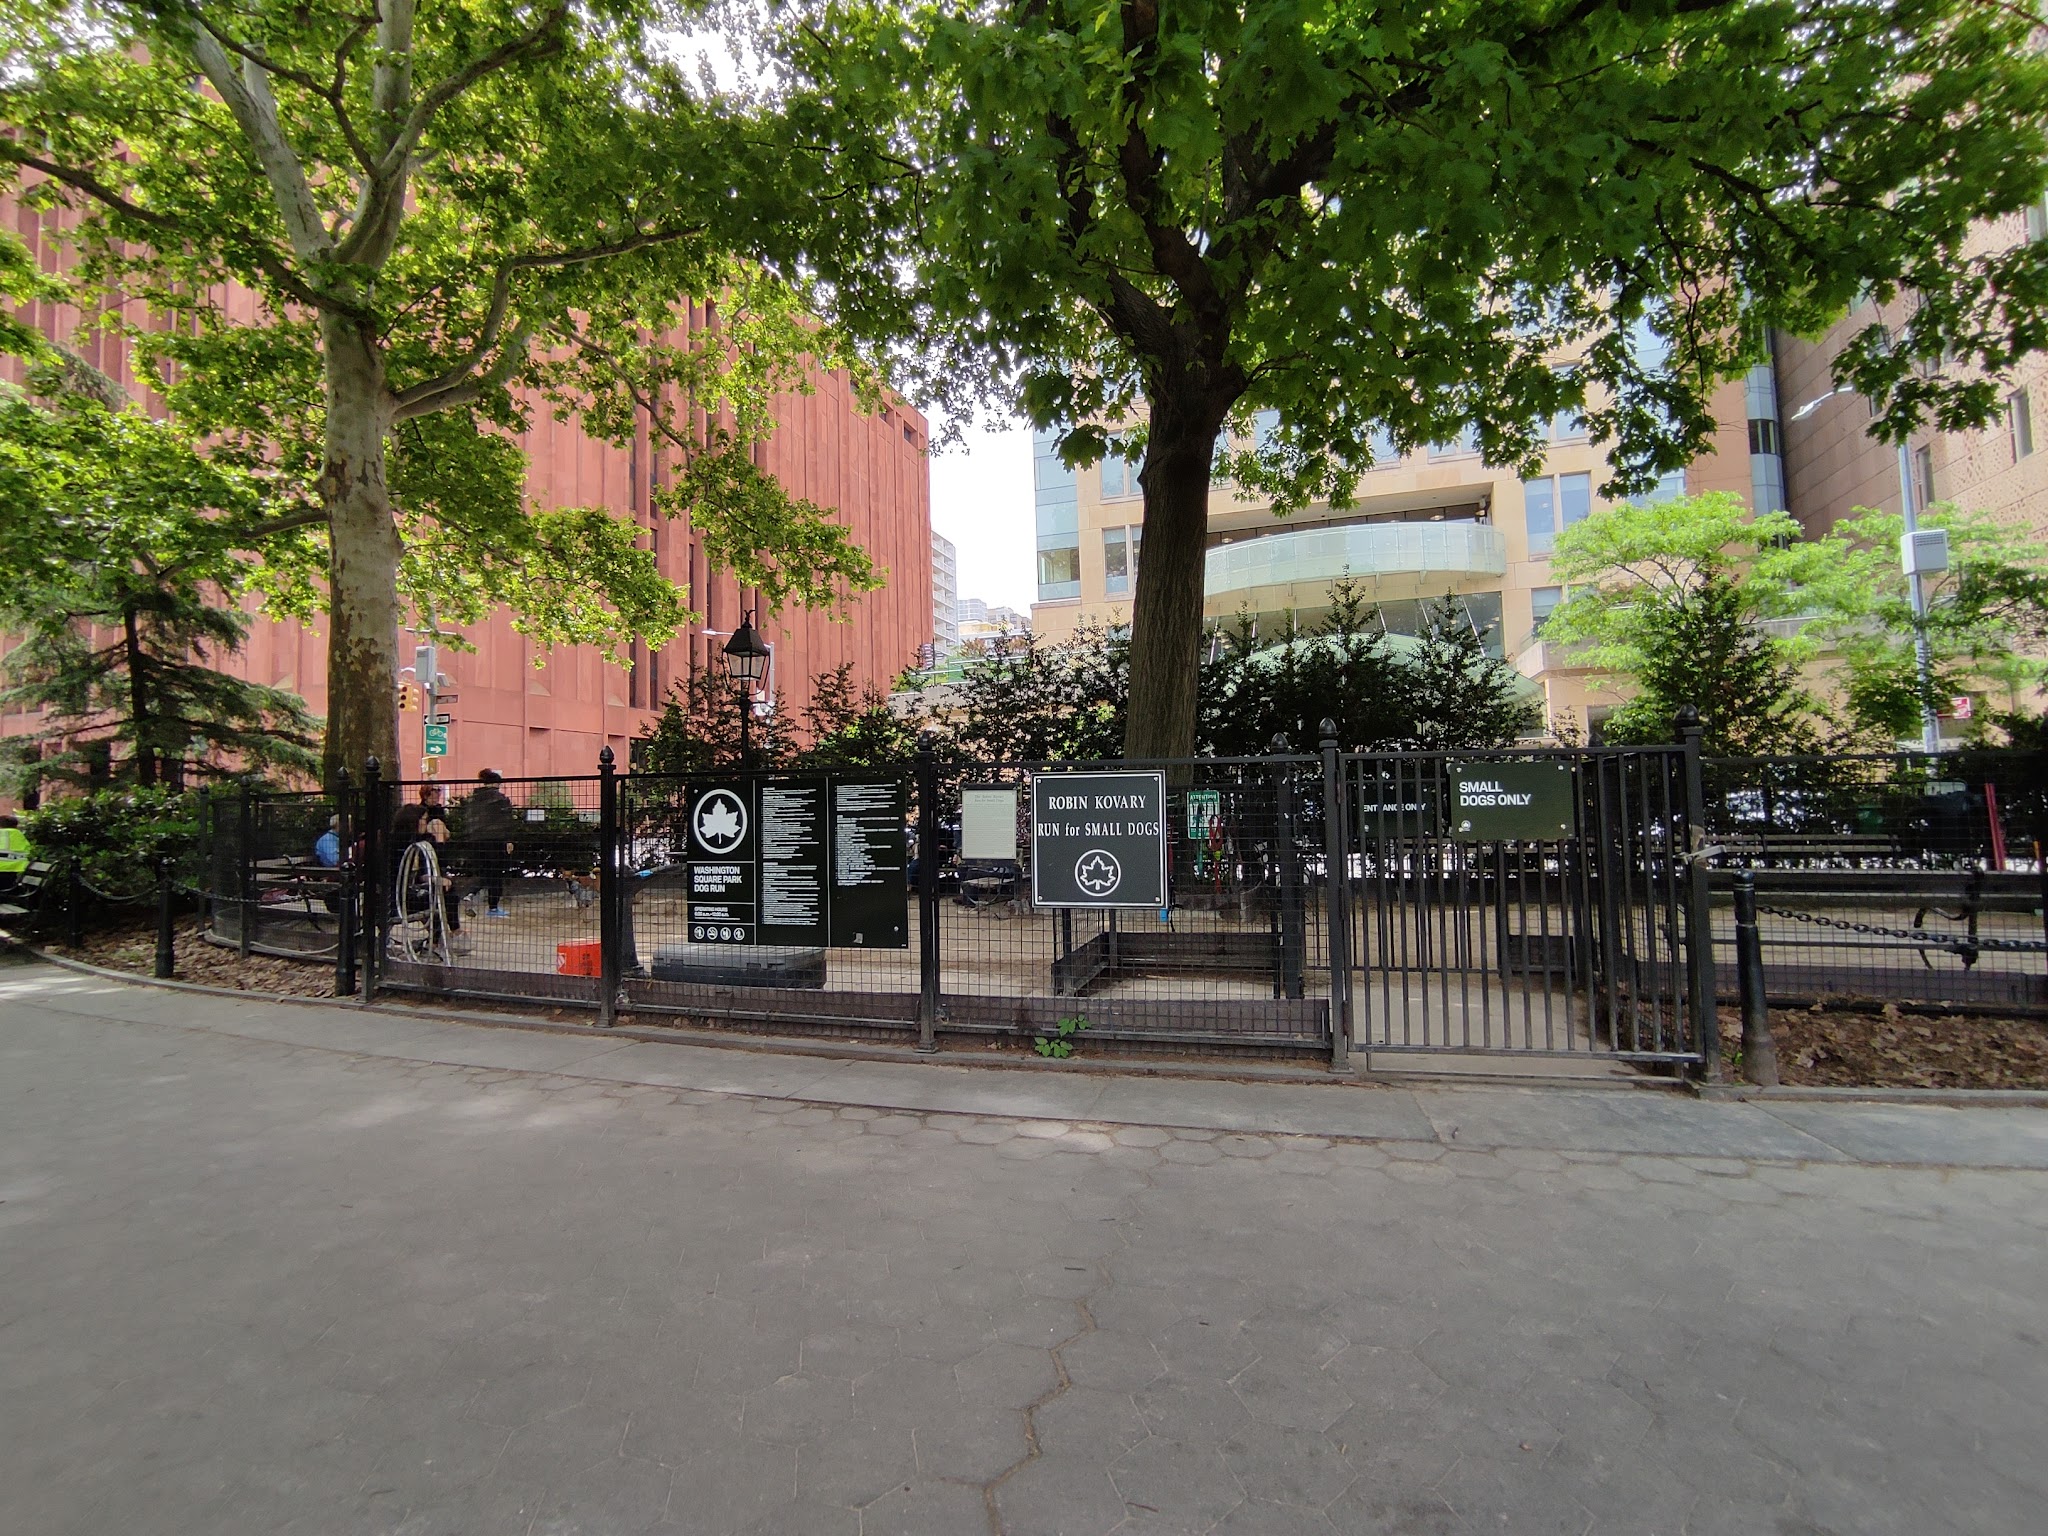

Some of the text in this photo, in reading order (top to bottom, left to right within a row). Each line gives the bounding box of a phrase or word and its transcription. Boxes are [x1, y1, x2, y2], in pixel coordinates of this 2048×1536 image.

[1459, 781, 1503, 793] SMALL
[1048, 795, 1146, 810] ROBIN KOVARY
[1460, 793, 1532, 807] DOGS ONLY
[1405, 803, 1427, 812] ONY
[1038, 822, 1160, 837] RUN for SMALL DOGS
[694, 866, 740, 874] WASHINGTON
[694, 875, 742, 883] SQUARE PARK
[694, 884, 725, 892] DOG RUN
